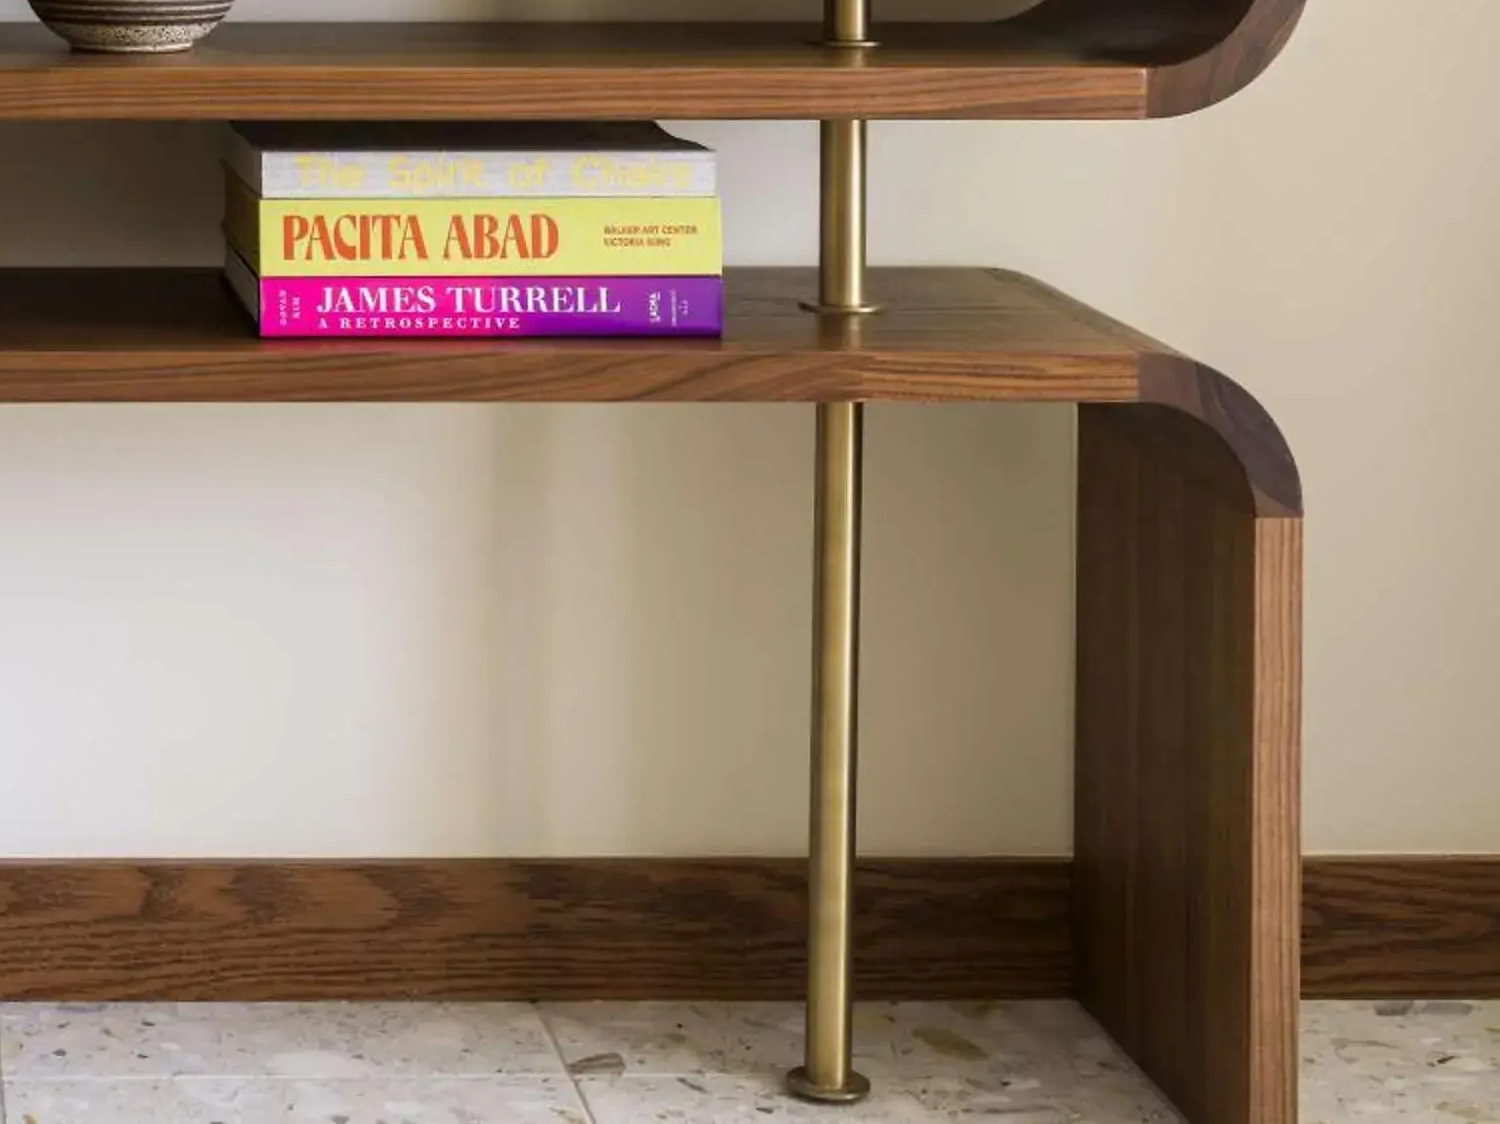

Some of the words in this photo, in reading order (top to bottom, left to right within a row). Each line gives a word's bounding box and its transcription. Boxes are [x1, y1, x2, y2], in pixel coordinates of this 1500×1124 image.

[293, 154, 365, 188] The
[506, 154, 548, 188] of
[283, 214, 428, 260] PACITA
[443, 214, 559, 260] ABAD
[603, 225, 641, 234] WALKER
[642, 225, 659, 234] ART
[661, 225, 697, 234] CENTER
[603, 237, 644, 247] VICTORIA
[317, 286, 436, 313] JAMES
[446, 286, 621, 313] TURRELL
[318, 317, 329, 329] A
[340, 317, 521, 329] RETROSPECTIVE
